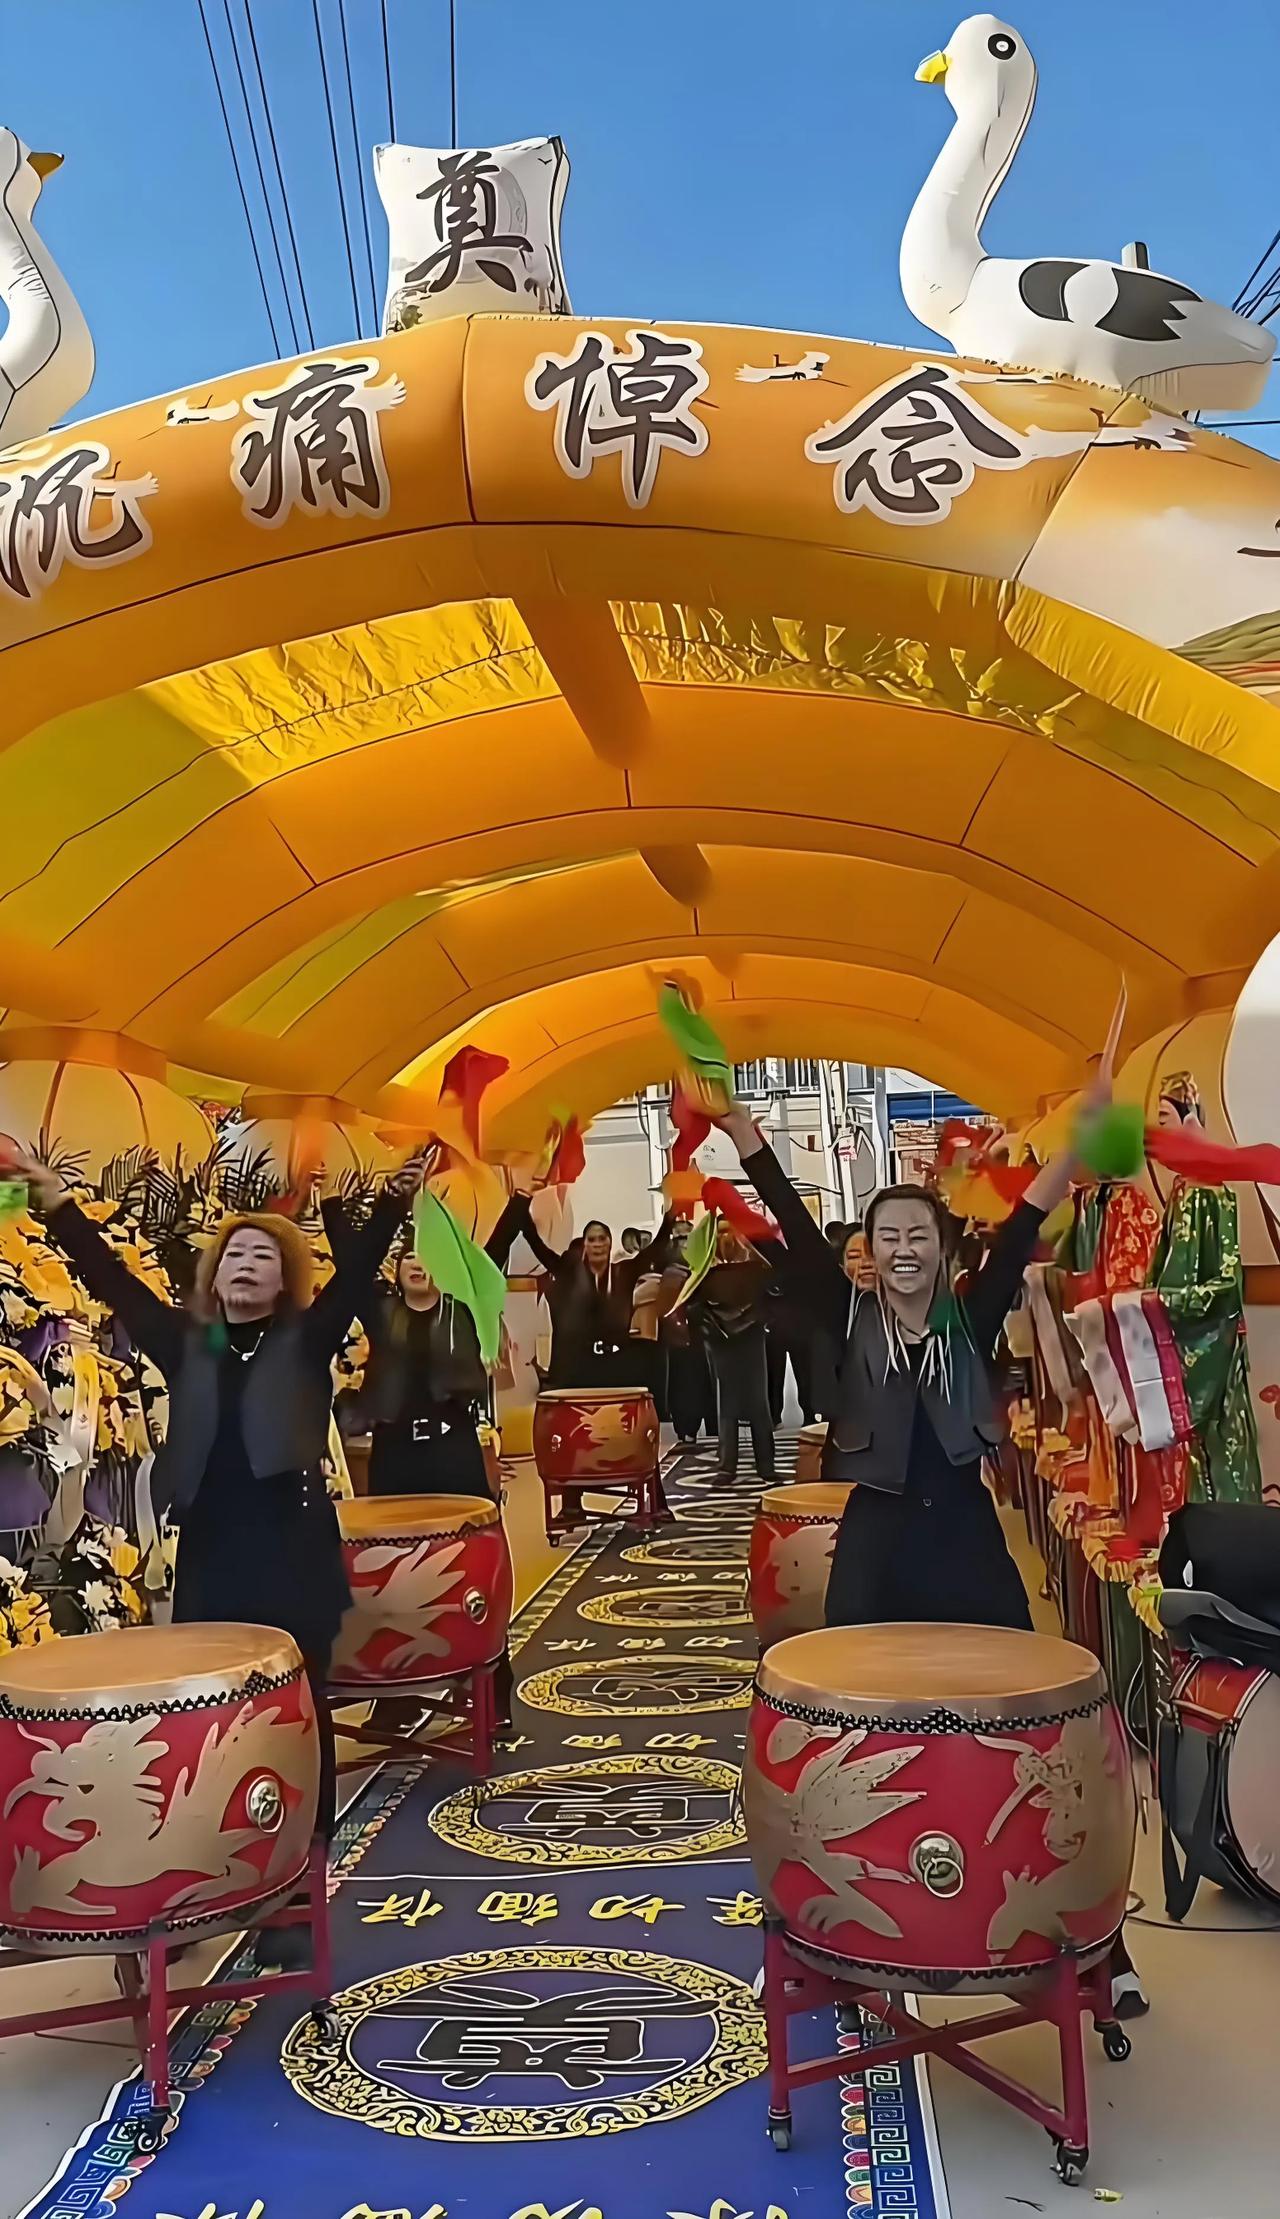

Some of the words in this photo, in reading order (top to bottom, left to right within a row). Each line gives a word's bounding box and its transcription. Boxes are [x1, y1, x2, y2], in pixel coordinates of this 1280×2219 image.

[405, 151, 534, 292] 奠
[0, 332, 1021, 598] 沉痛悼念
[367, 1982, 721, 2090] 奠
